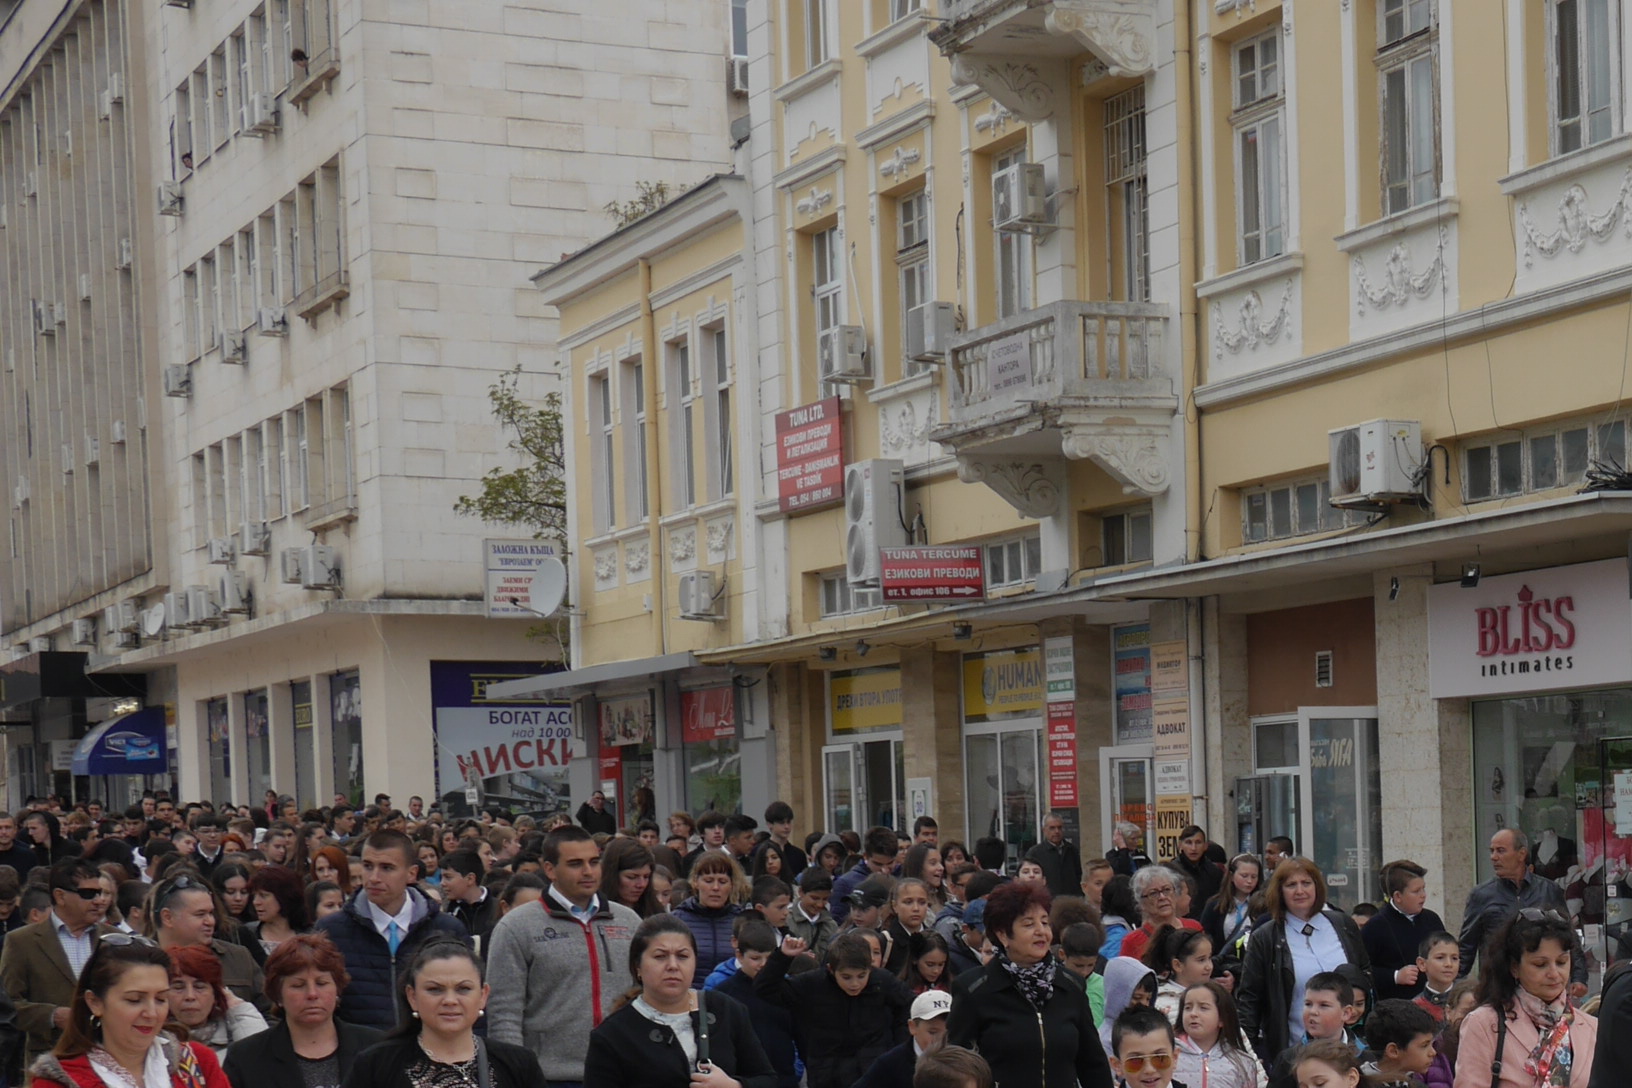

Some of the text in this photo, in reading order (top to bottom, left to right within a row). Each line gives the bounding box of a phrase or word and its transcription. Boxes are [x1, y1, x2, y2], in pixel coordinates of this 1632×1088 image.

[790, 404, 824, 428] TUNA LTD.
[492, 545, 554, 556] ЗАЛОЖНА КЪЩА
[886, 549, 976, 560] TUNA TERCUME
[885, 567, 980, 579] ЕЗИКОВИ ПРЕВОДИ
[910, 587, 934, 596] офис
[1474, 595, 1576, 657] BLISS
[1481, 656, 1573, 678] intimates
[837, 693, 859, 712] ДРЕХИ
[489, 710, 572, 724] БОГАТ АС
[512, 728, 572, 738] над 10 00
[1157, 722, 1186, 736] АДВОКАТ
[1158, 836, 1182, 858] ЗЕМ
[934, 1000, 948, 1008] NY
